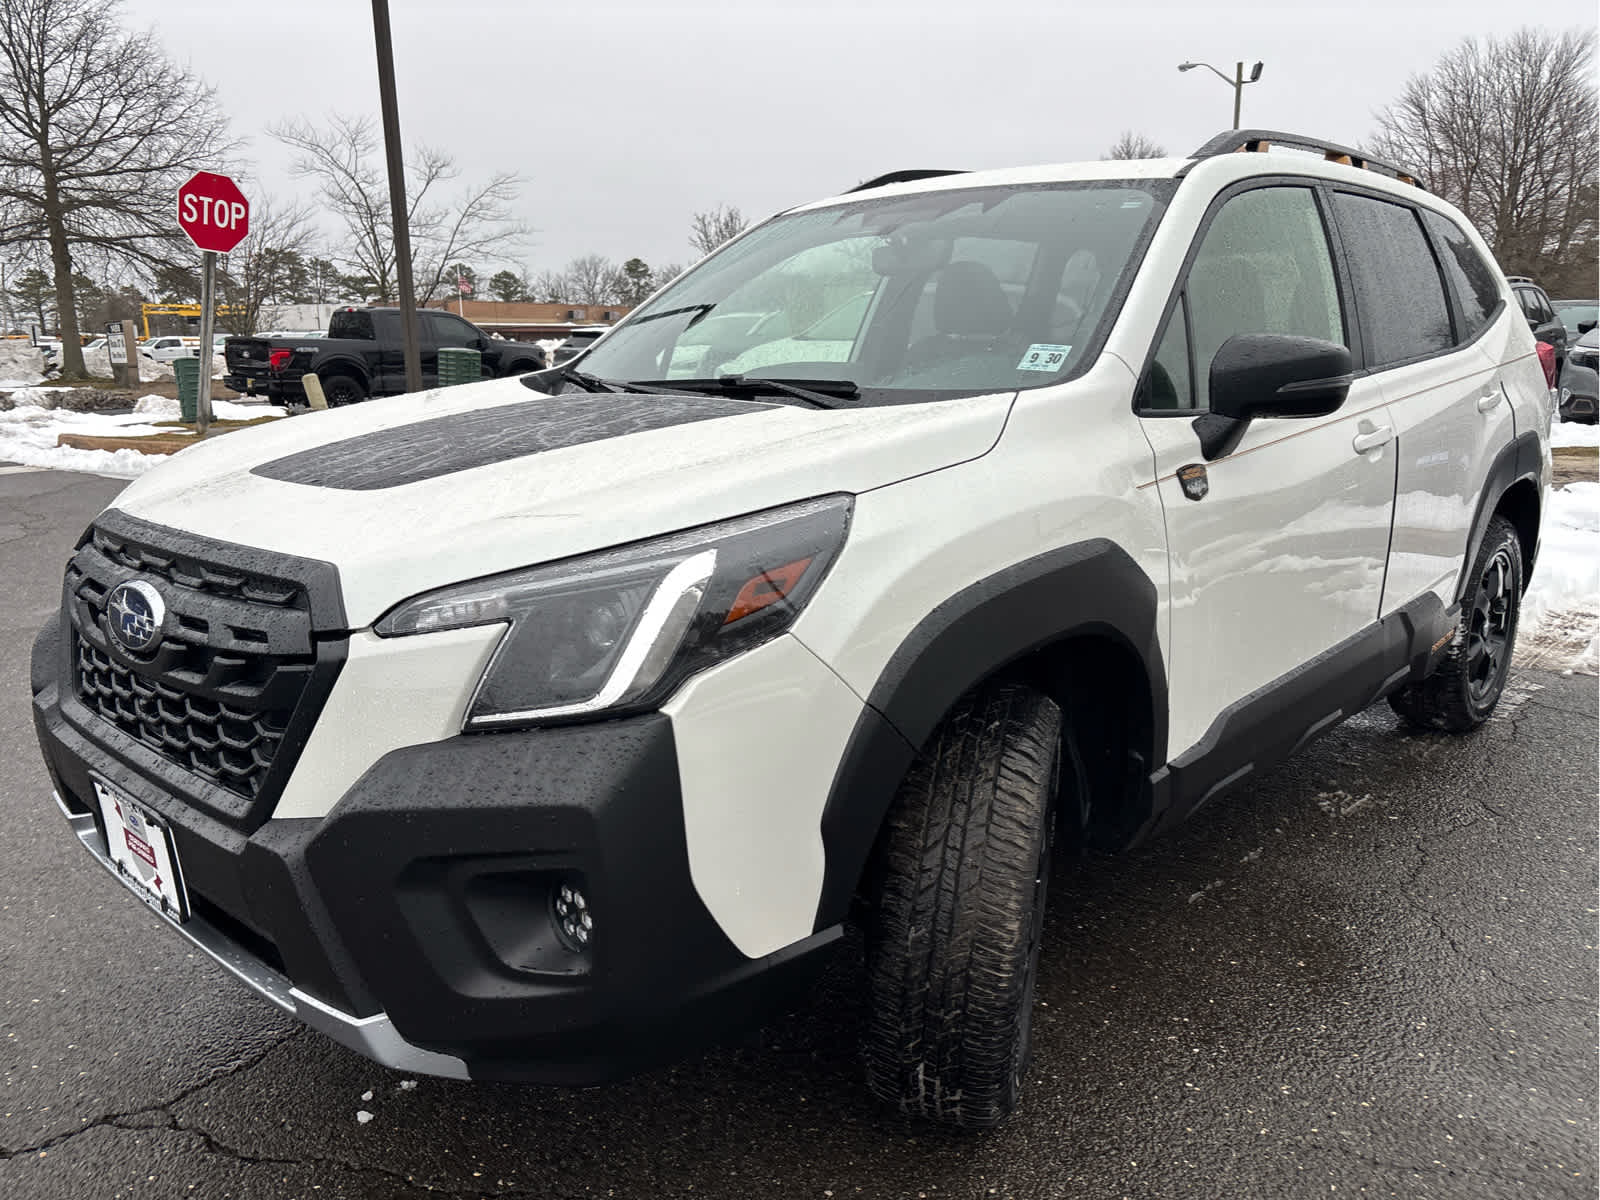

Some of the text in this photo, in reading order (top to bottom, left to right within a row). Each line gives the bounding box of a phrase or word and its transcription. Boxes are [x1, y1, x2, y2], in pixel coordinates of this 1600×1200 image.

[182, 193, 246, 230] STOP
[1030, 352, 1062, 364] 9 30
